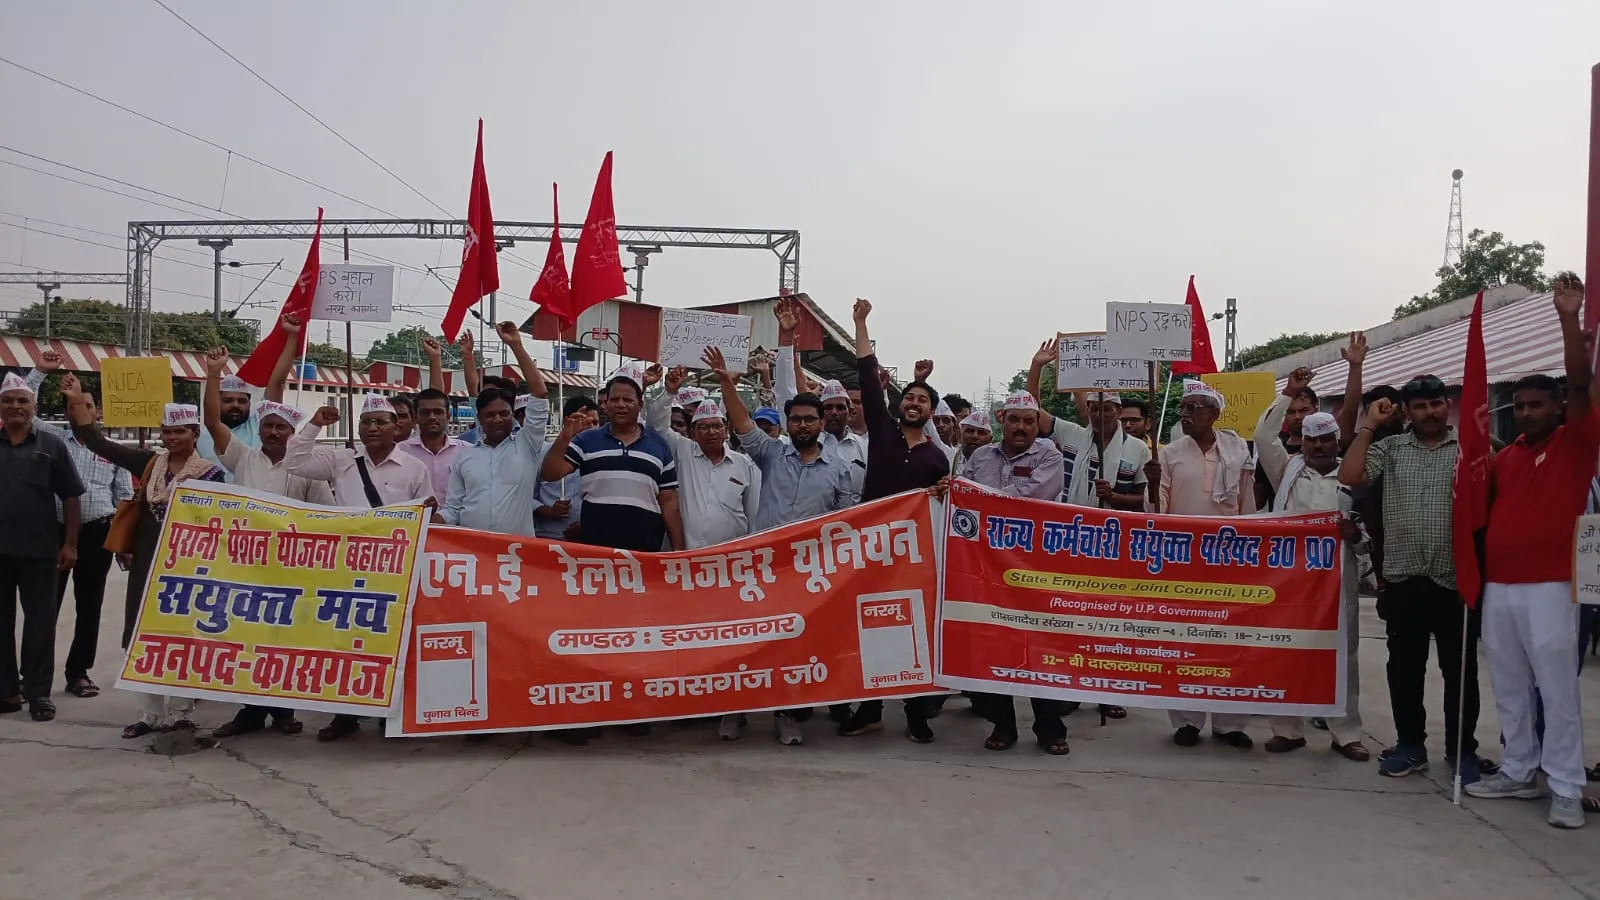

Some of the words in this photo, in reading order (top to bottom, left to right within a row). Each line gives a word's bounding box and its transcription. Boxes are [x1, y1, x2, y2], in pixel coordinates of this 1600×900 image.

[319, 270, 338, 285] PS
[1115, 310, 1148, 332] NPS
[663, 324, 680, 342] We
[729, 334, 750, 349] OPS
[164, 516, 224, 570] पुरानी
[227, 518, 273, 566] पेंशन
[276, 523, 341, 570] योजना
[344, 528, 411, 575] बहाली
[986, 515, 1035, 552] राज्य
[1042, 513, 1121, 560] कर्मचारी
[1129, 520, 1194, 575] संयुक्त
[1200, 525, 1262, 568] परिषद
[548, 543, 646, 596] रेलवे
[660, 547, 777, 602] मजदूर
[790, 519, 924, 594] यूनियन
[1010, 572, 1048, 584] State
[1051, 576, 1127, 590] Employee
[1131, 582, 1170, 593] Joint
[1241, 587, 1271, 599] U.P.
[157, 566, 304, 633] संयुक्त
[315, 578, 398, 634] मंच
[1049, 597, 1117, 612] (Recognised
[1119, 602, 1134, 615] by
[1135, 603, 1156, 614] U.P.
[1158, 604, 1229, 620] Government)
[864, 603, 907, 621] नरमू
[990, 611, 1039, 626] शासनादेश
[1042, 616, 1074, 629] संख्या
[1087, 620, 1119, 633] 5/3/72
[557, 630, 637, 649] मण्डल
[660, 615, 797, 648] इज्जतनगर
[423, 635, 469, 655] नरमू
[1134, 646, 1181, 659] कार्यालय
[870, 674, 898, 688] चुनाव
[1175, 664, 1232, 679] लखनऊ
[528, 680, 613, 705] शाखा
[643, 663, 774, 698] कासगंज
[989, 666, 1072, 686] जनपद
[1177, 682, 1287, 701] कासगंज
[423, 709, 452, 723] चुनाव
